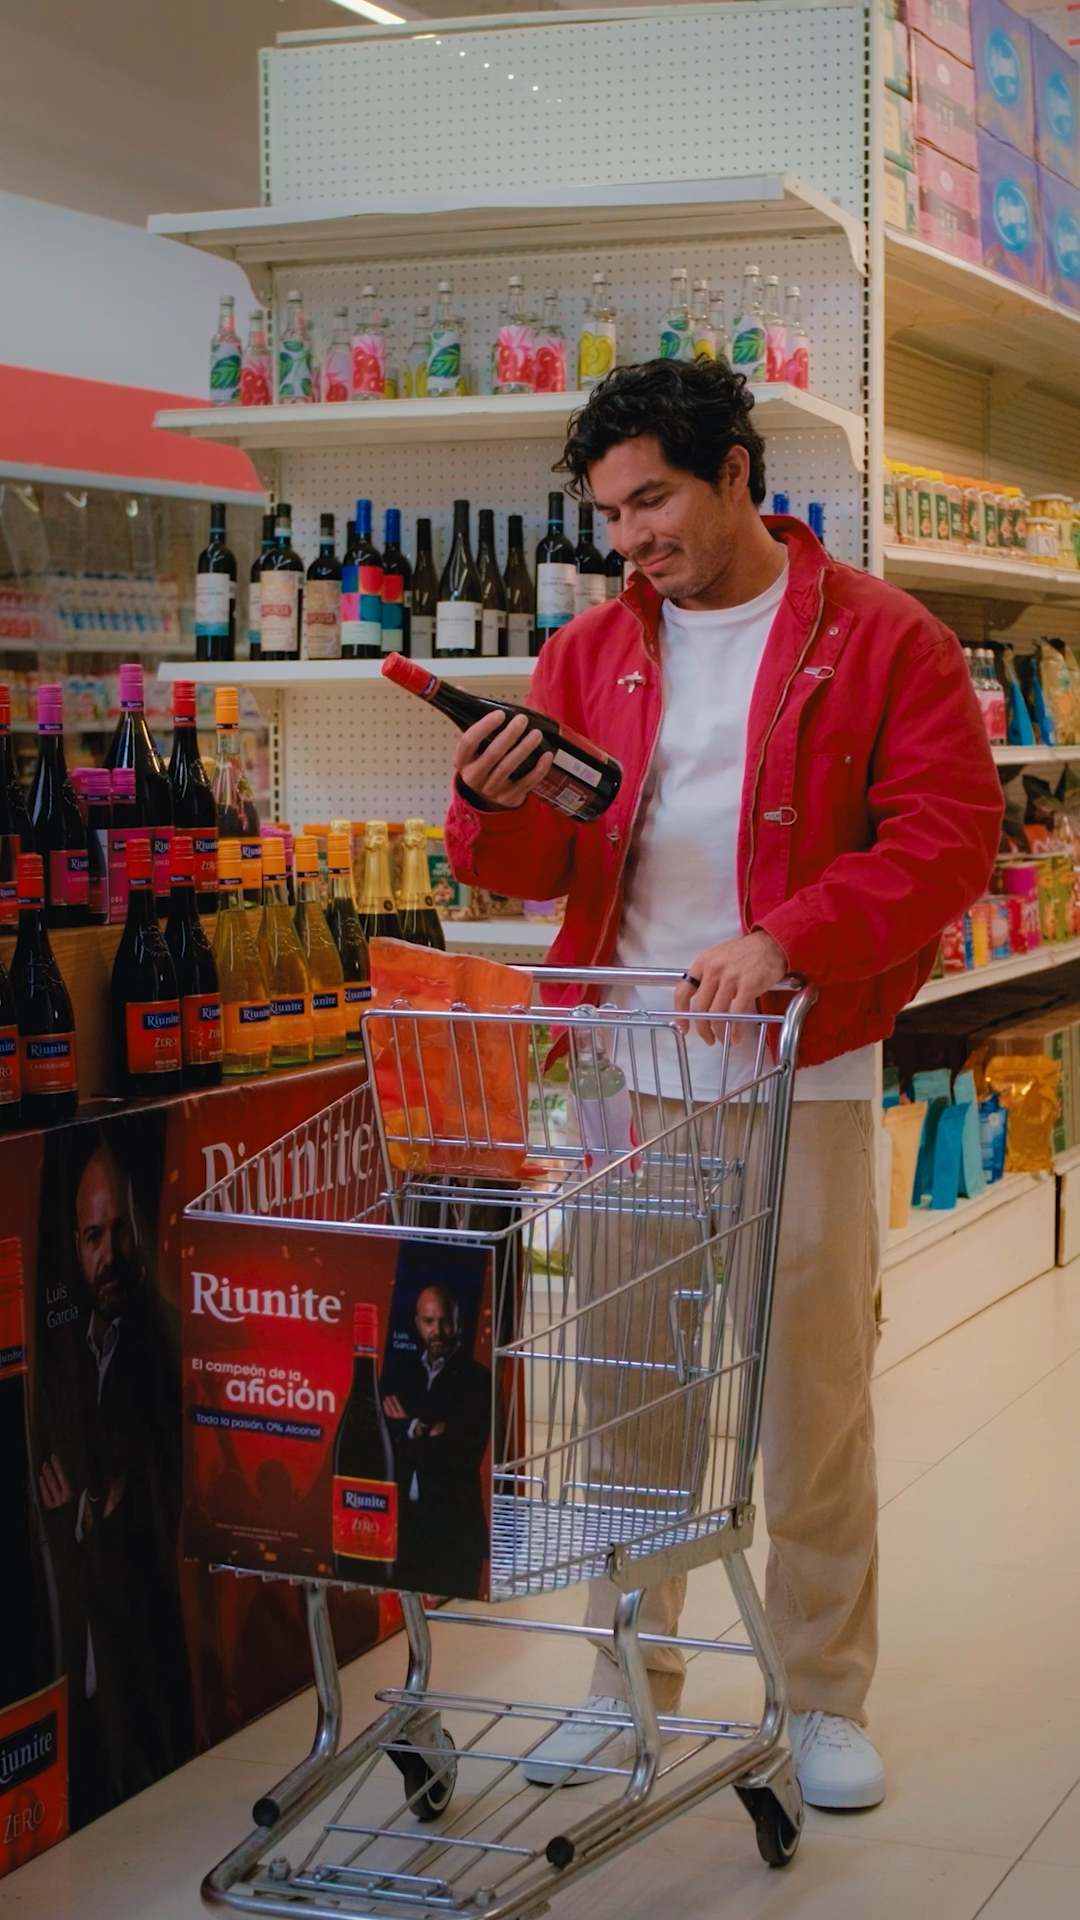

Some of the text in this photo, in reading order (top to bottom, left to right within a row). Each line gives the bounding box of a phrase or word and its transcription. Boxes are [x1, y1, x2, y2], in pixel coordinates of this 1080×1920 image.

[30, 1043, 69, 1057] Riunite
[154, 1038, 177, 1048] ZERO
[201, 1118, 374, 1215] Riunite
[46, 1282, 68, 1304] Luis
[191, 1271, 342, 1323] Riunite
[192, 1358, 302, 1382] El campeón de la
[226, 1378, 336, 1413] afición
[196, 1413, 219, 1425] Toda
[220, 1416, 230, 1426] la
[266, 1421, 284, 1432] 0%
[285, 1424, 321, 1437] Alcohol
[345, 1491, 387, 1510] Riunite
[0, 1732, 53, 1784] iunite
[3, 1800, 45, 1844] ZERO
